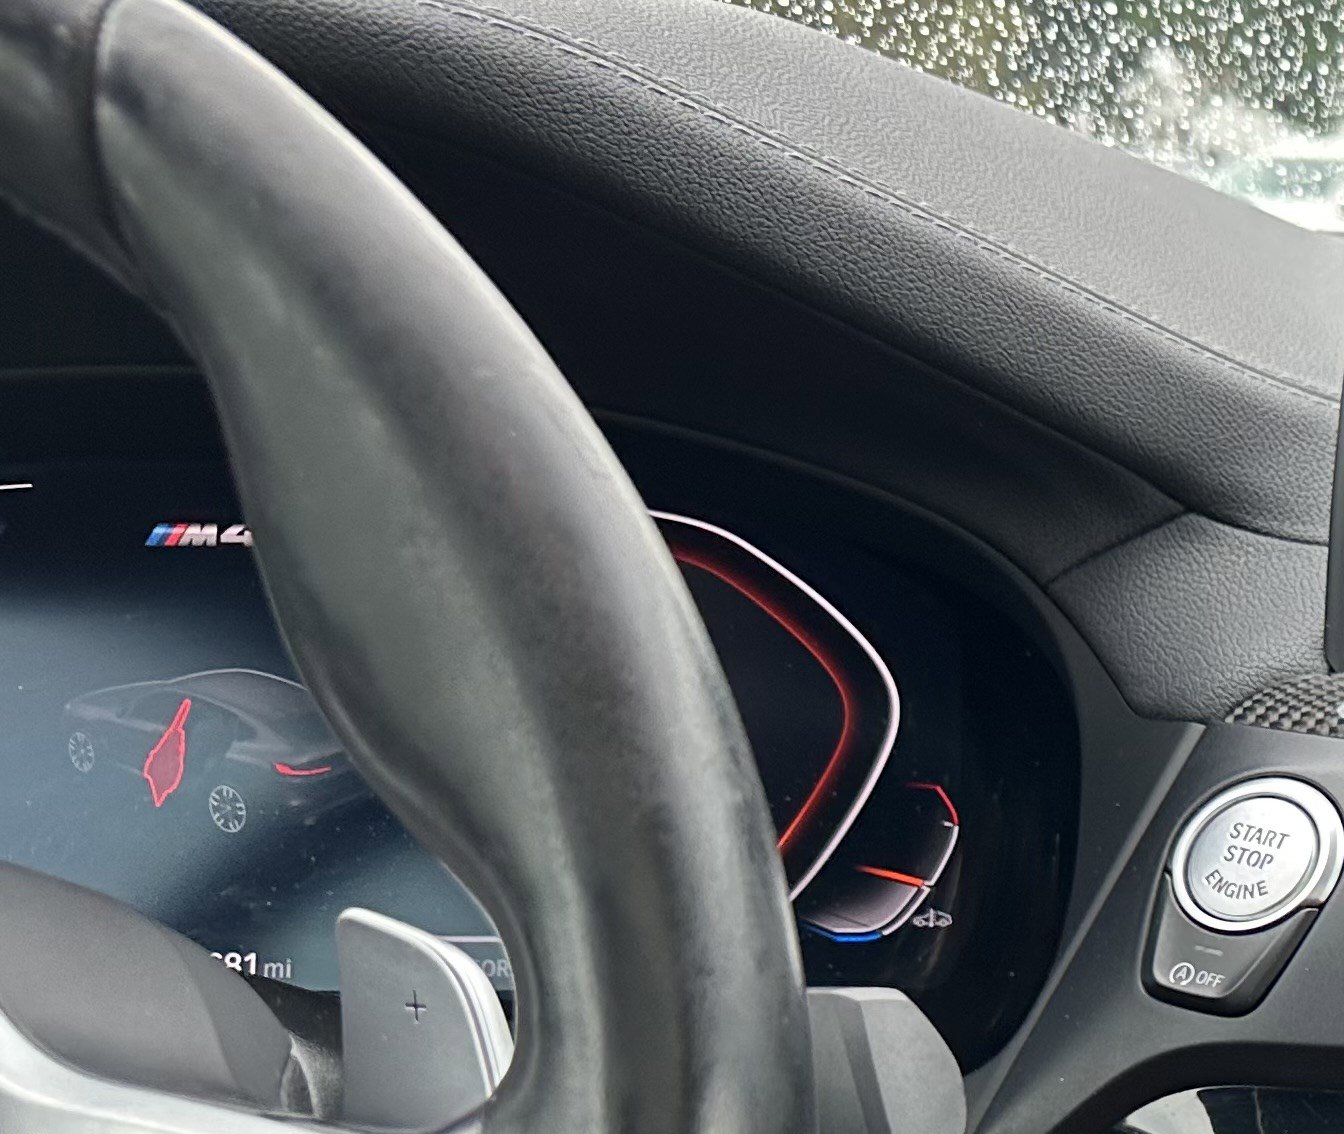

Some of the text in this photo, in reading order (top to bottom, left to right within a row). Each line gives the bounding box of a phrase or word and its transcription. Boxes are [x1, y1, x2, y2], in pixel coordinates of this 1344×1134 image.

[1229, 822, 1291, 849] START
[1223, 845, 1275, 870] STOP
[1204, 869, 1269, 900] ENGINE
[263, 957, 292, 978] mi
[1195, 971, 1226, 988] OFF
